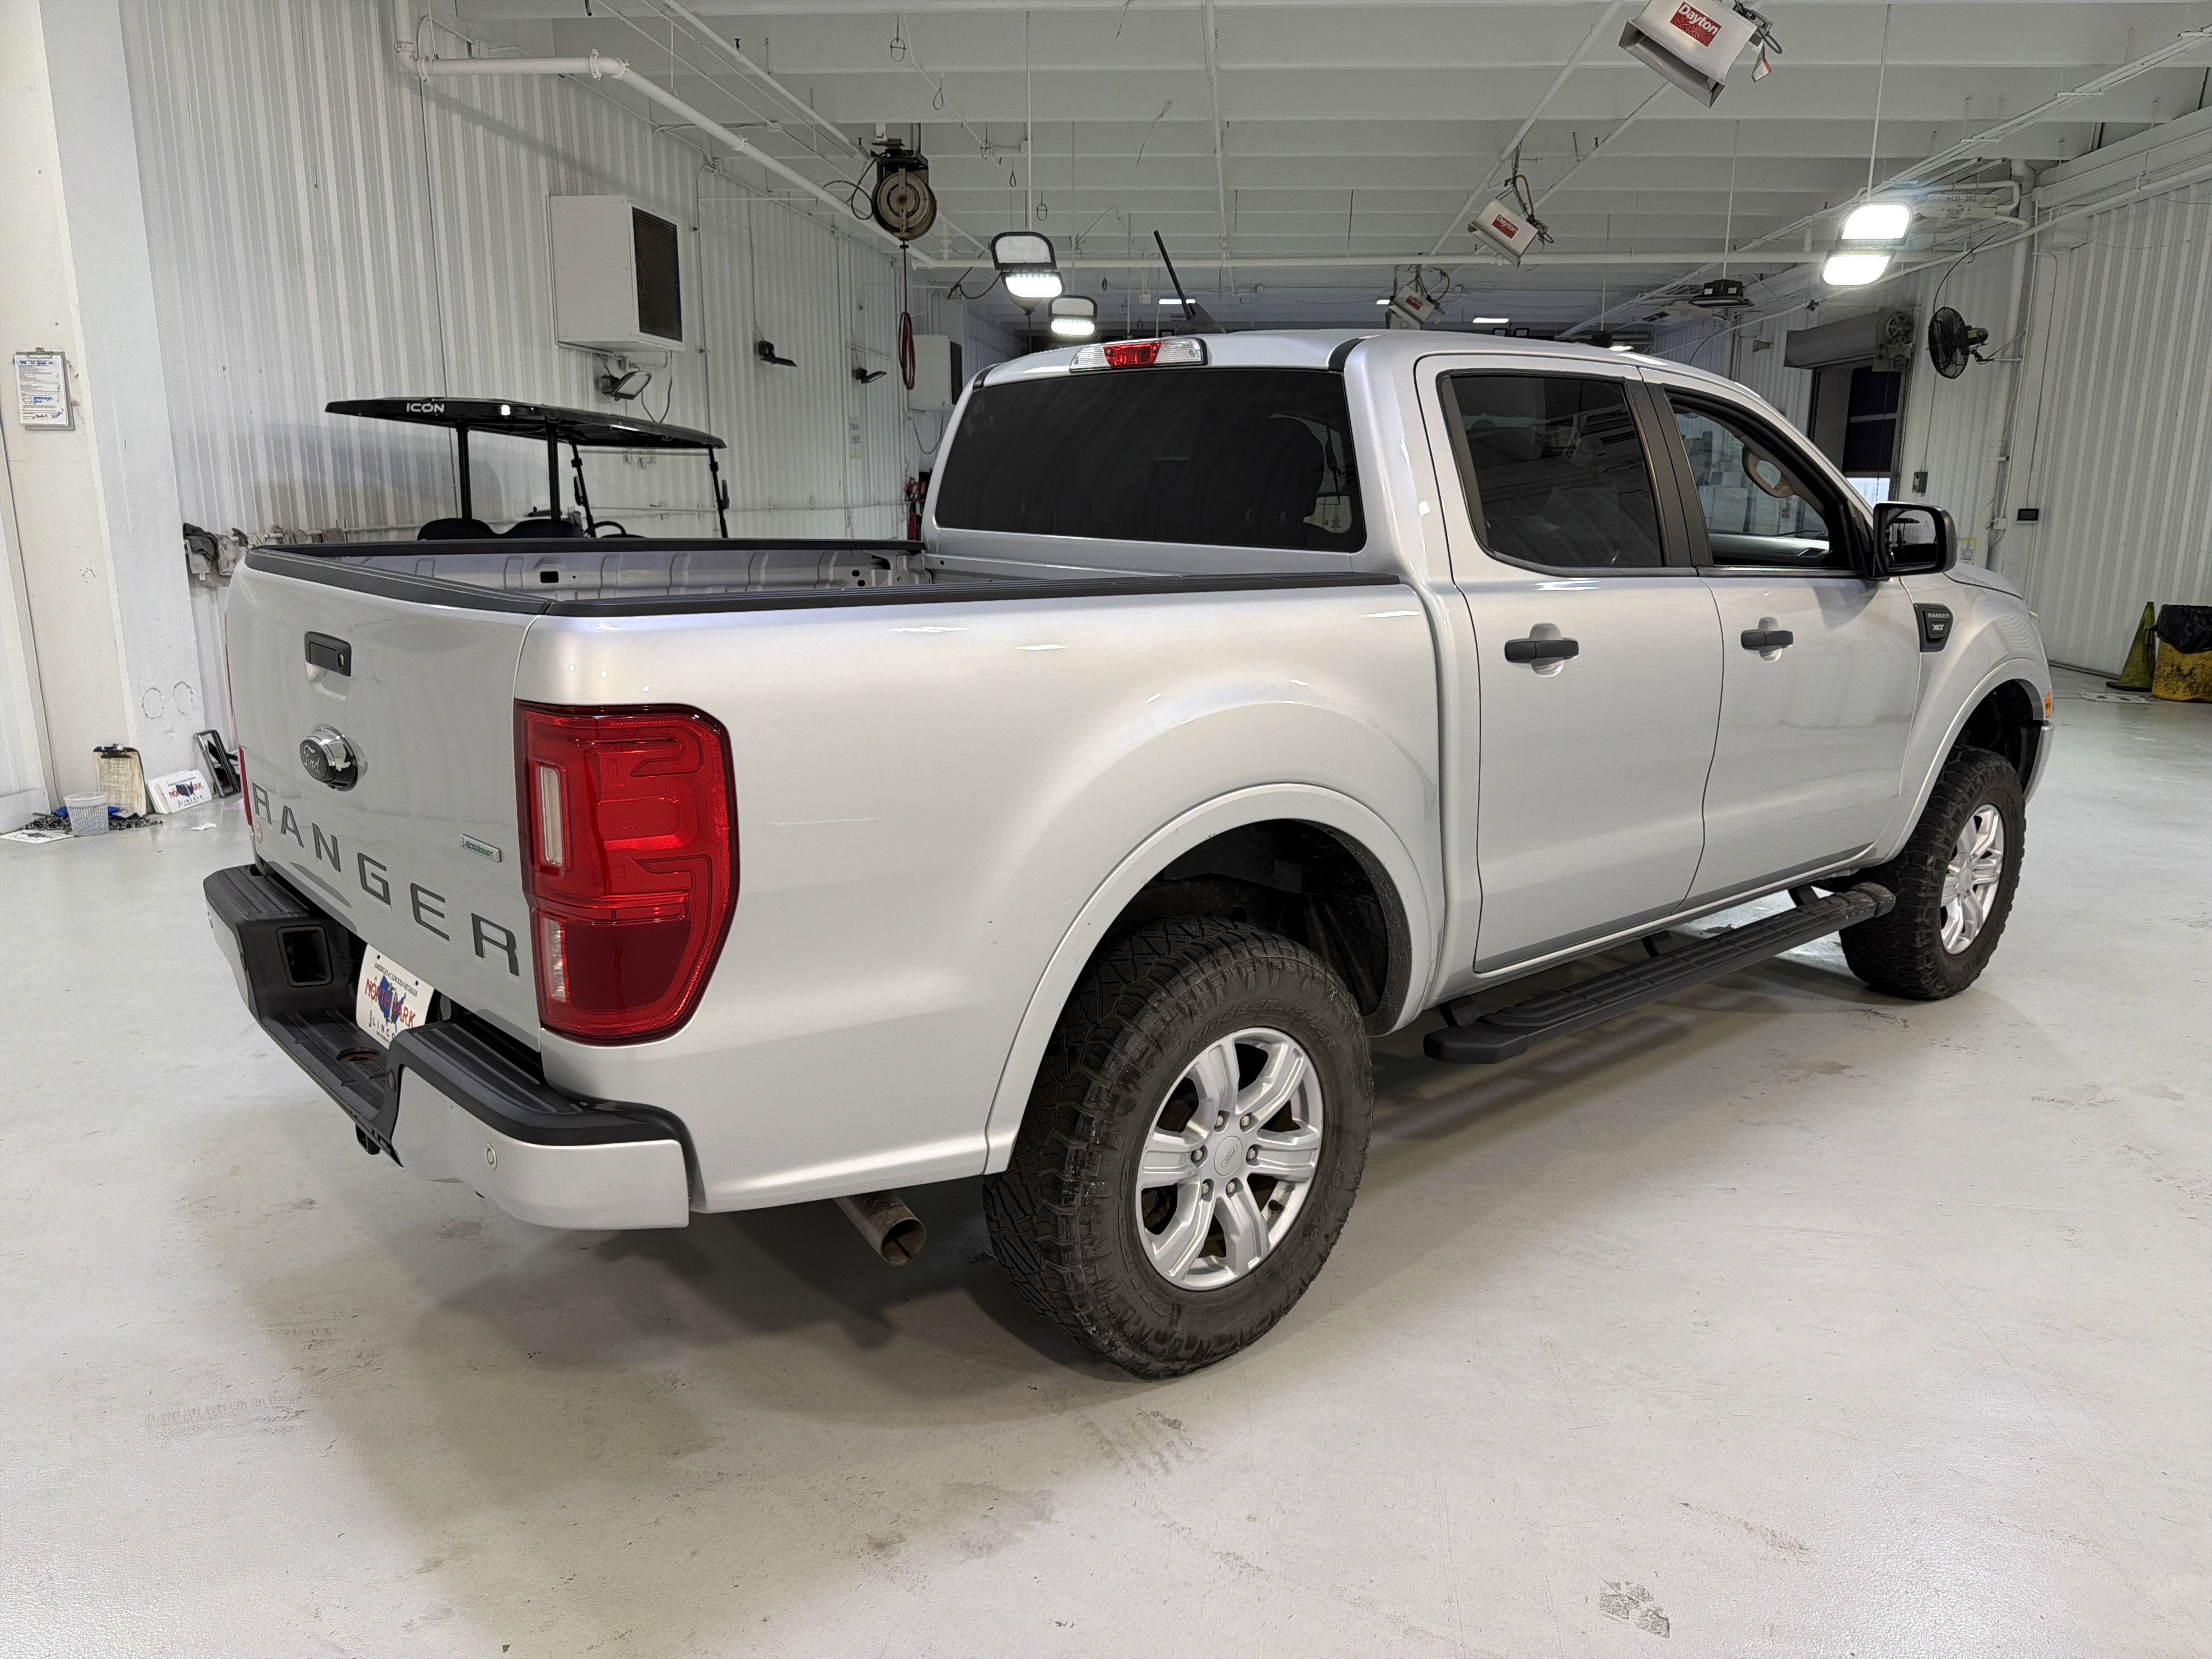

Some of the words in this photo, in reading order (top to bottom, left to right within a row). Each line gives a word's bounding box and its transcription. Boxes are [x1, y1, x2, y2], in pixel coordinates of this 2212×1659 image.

[1678, 3, 1718, 35] Dayton
[1497, 216, 1518, 233] Dayton
[406, 403, 445, 413] ICON
[303, 744, 321, 774] Ford
[252, 782, 520, 977] RANGER
[393, 995, 416, 1028] PARK
[373, 1017, 396, 1040] LINCO
